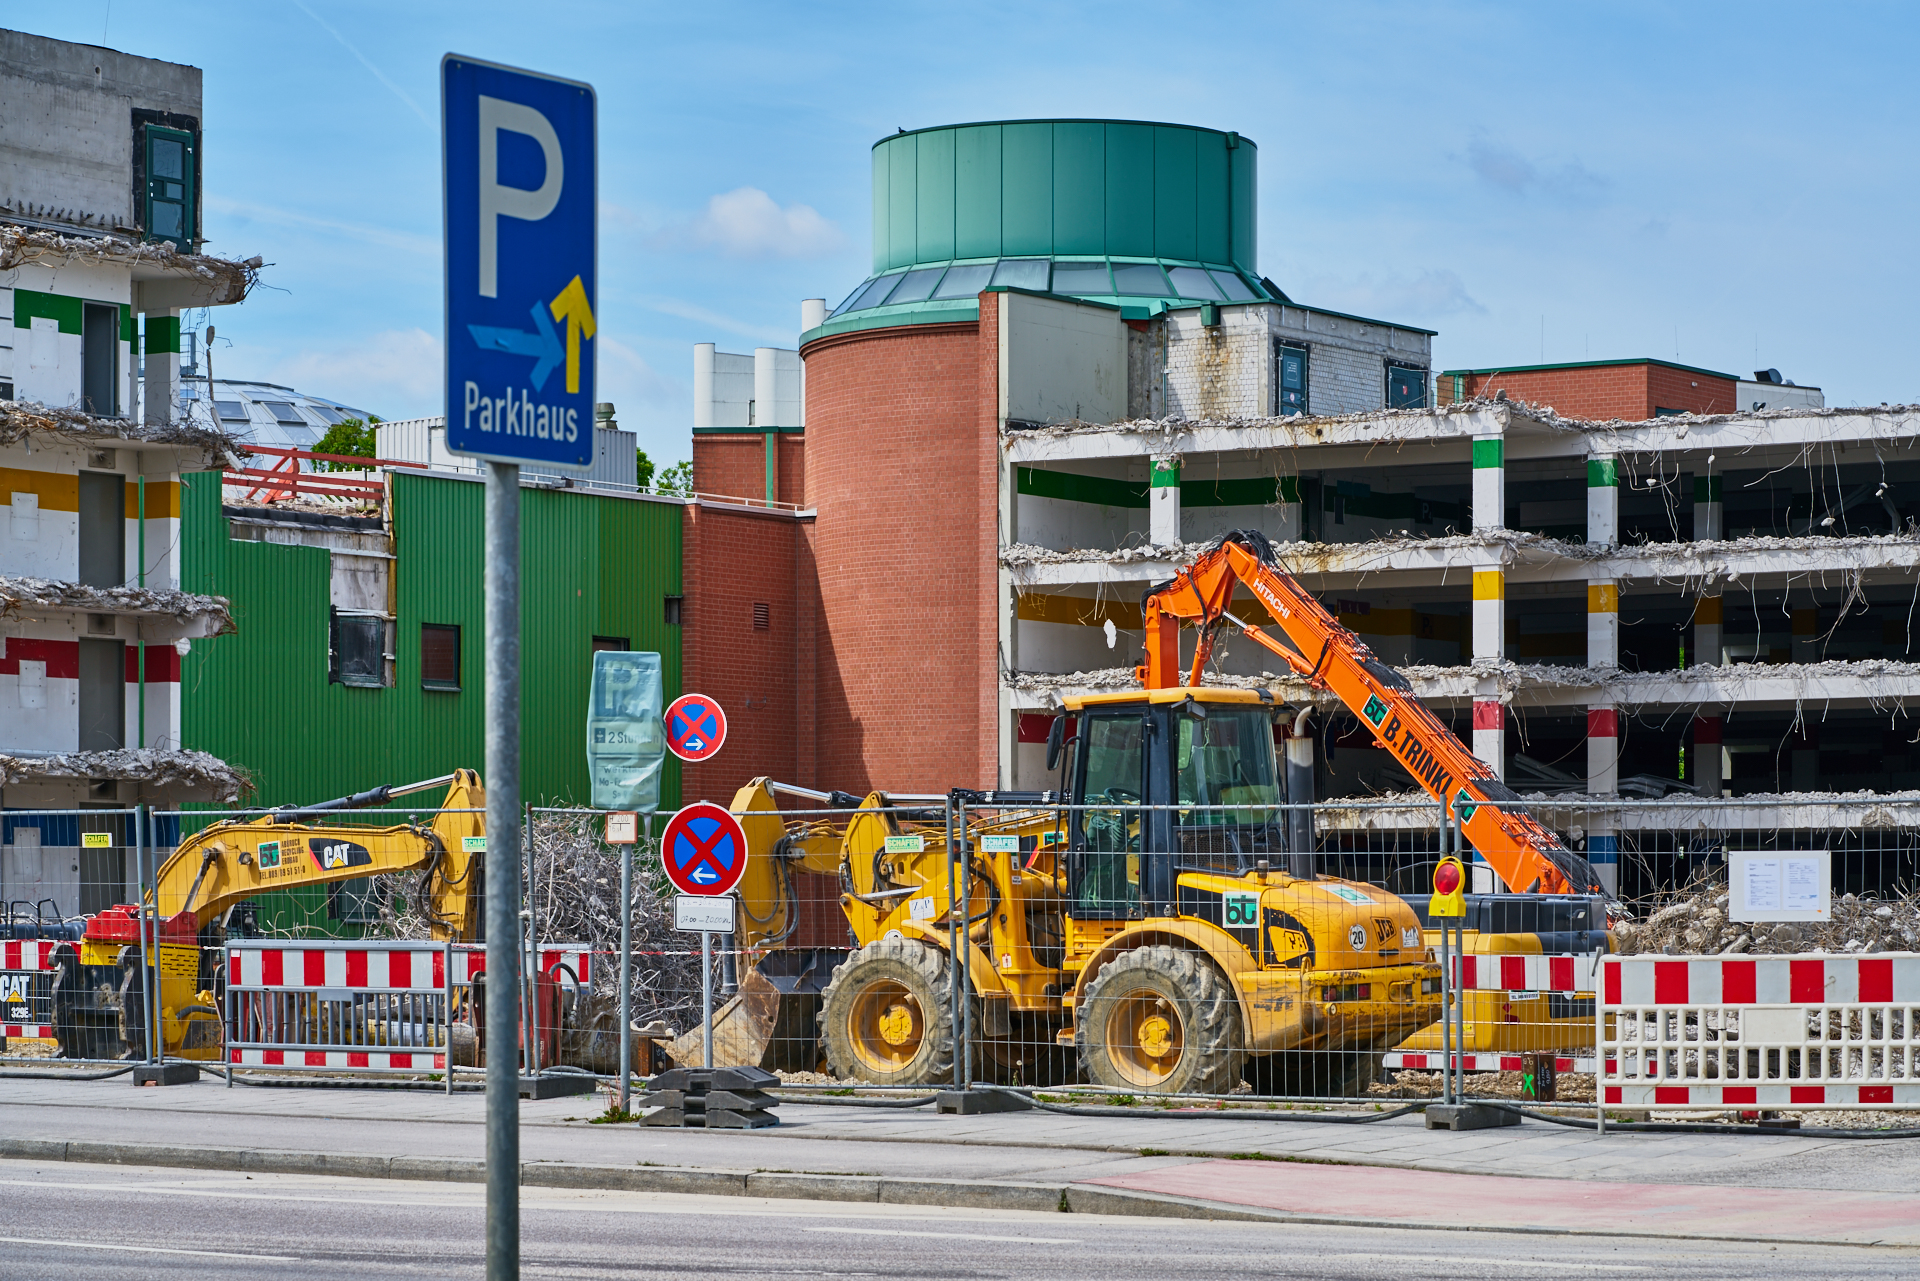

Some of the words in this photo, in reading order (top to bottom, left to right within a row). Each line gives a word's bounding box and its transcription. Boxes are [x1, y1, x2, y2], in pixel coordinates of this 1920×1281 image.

[479, 94, 564, 299] P
[464, 380, 579, 444] Parkhaus
[1253, 577, 1291, 620] HITACHI
[605, 660, 639, 710] P
[608, 732, 615, 744] 2
[618, 731, 658, 744] Stunden
[323, 843, 350, 869] CAT
[1352, 930, 1364, 945] 20
[1375, 919, 1395, 943] JCB
[0, 974, 30, 1003] CAT
[11, 1006, 29, 1019] 329E
